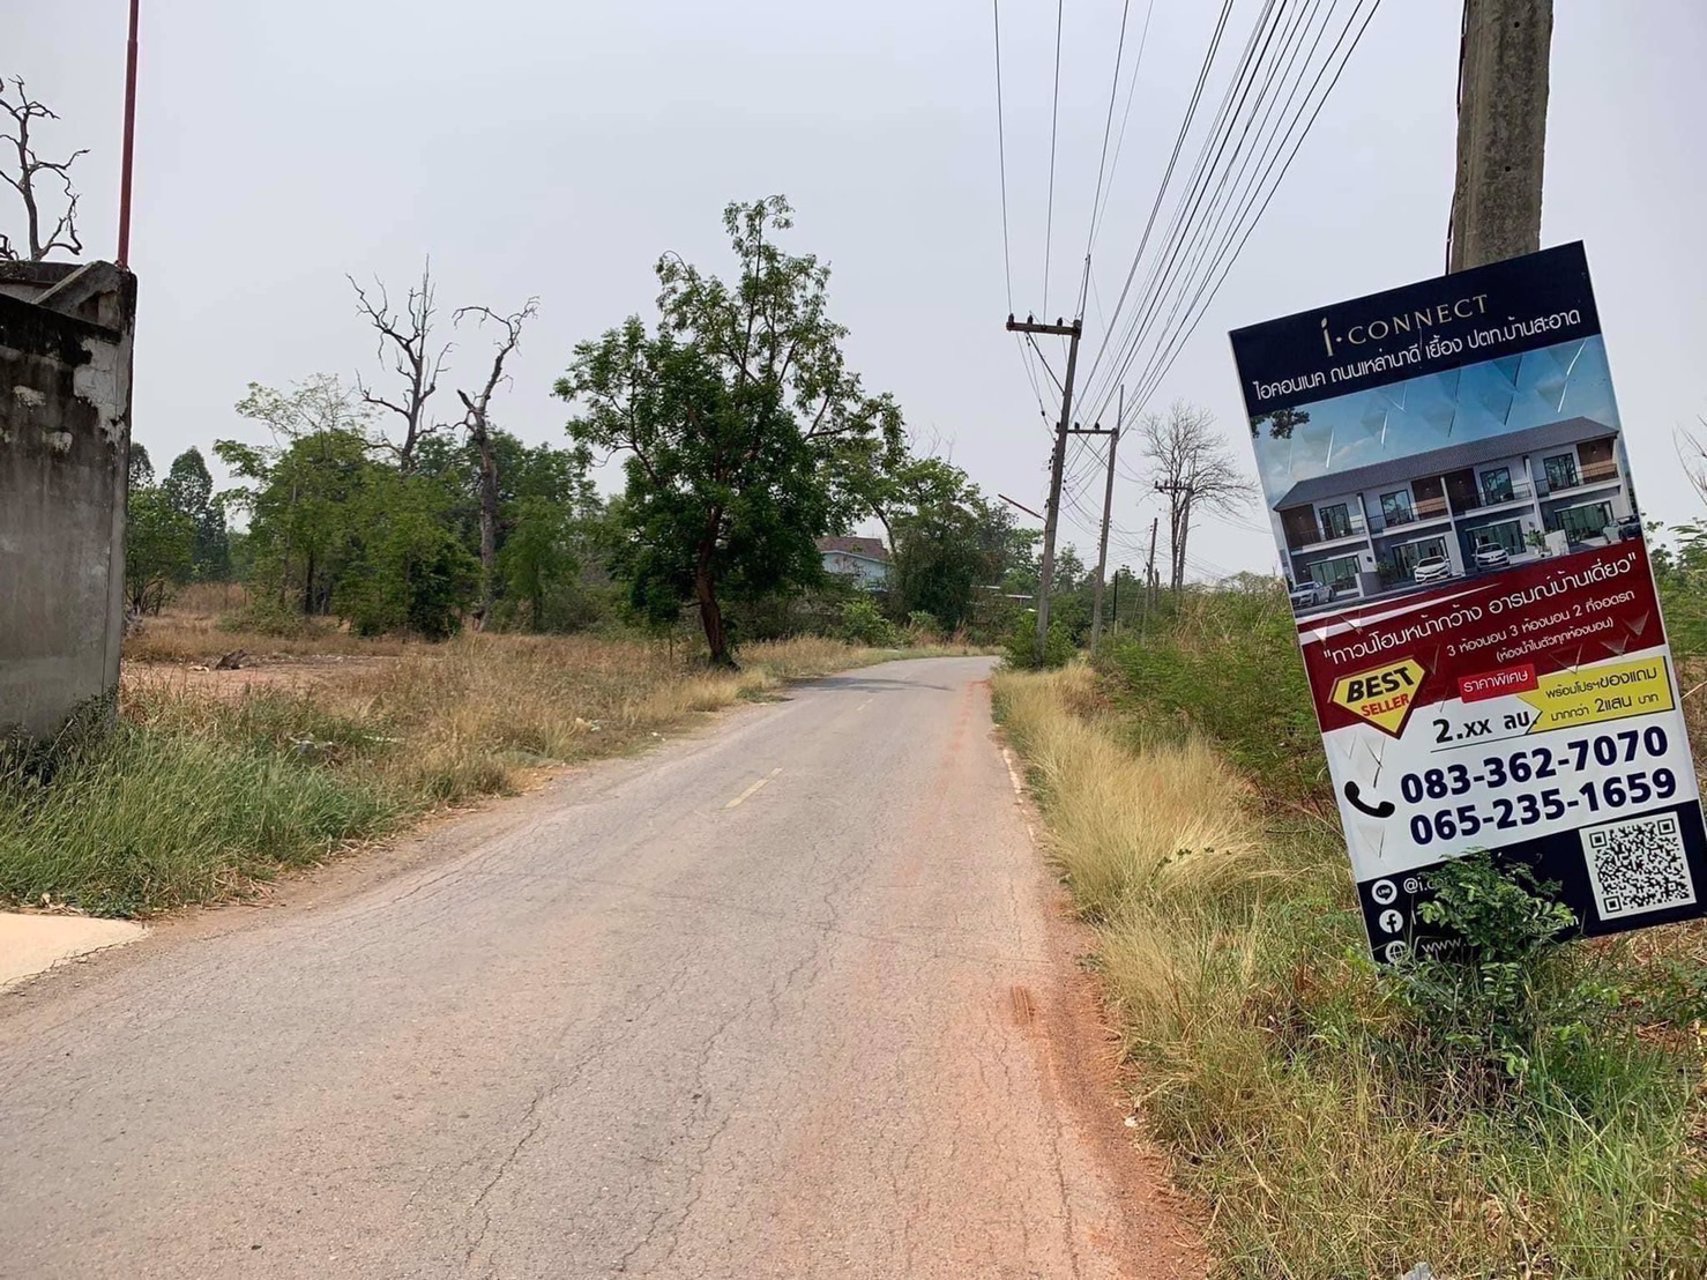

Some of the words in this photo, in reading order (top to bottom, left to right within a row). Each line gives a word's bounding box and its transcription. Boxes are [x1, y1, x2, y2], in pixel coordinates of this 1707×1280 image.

[1253, 371, 1326, 400] ไอคอนเนค
[1330, 343, 1422, 383] ถนนเหล่านาดี
[1426, 334, 1462, 359] เยื้อง
[1467, 309, 1581, 349] ปตท.บ้านสะอาด
[1447, 645, 1456, 657] 3
[1510, 625, 1519, 637] 3
[1574, 604, 1583, 617] 2
[1347, 667, 1414, 703] BEST
[1463, 670, 1529, 692] ราคาพิเศษ
[1361, 693, 1409, 716] SELLER
[1551, 703, 1590, 721] มากกว่า
[1595, 695, 1632, 713] 2แสน
[1638, 693, 1659, 705] บาท
[1433, 718, 1492, 744] 2.xx
[1401, 726, 1668, 804] 083-362-7070
[1410, 767, 1677, 845] 065-235-1659
